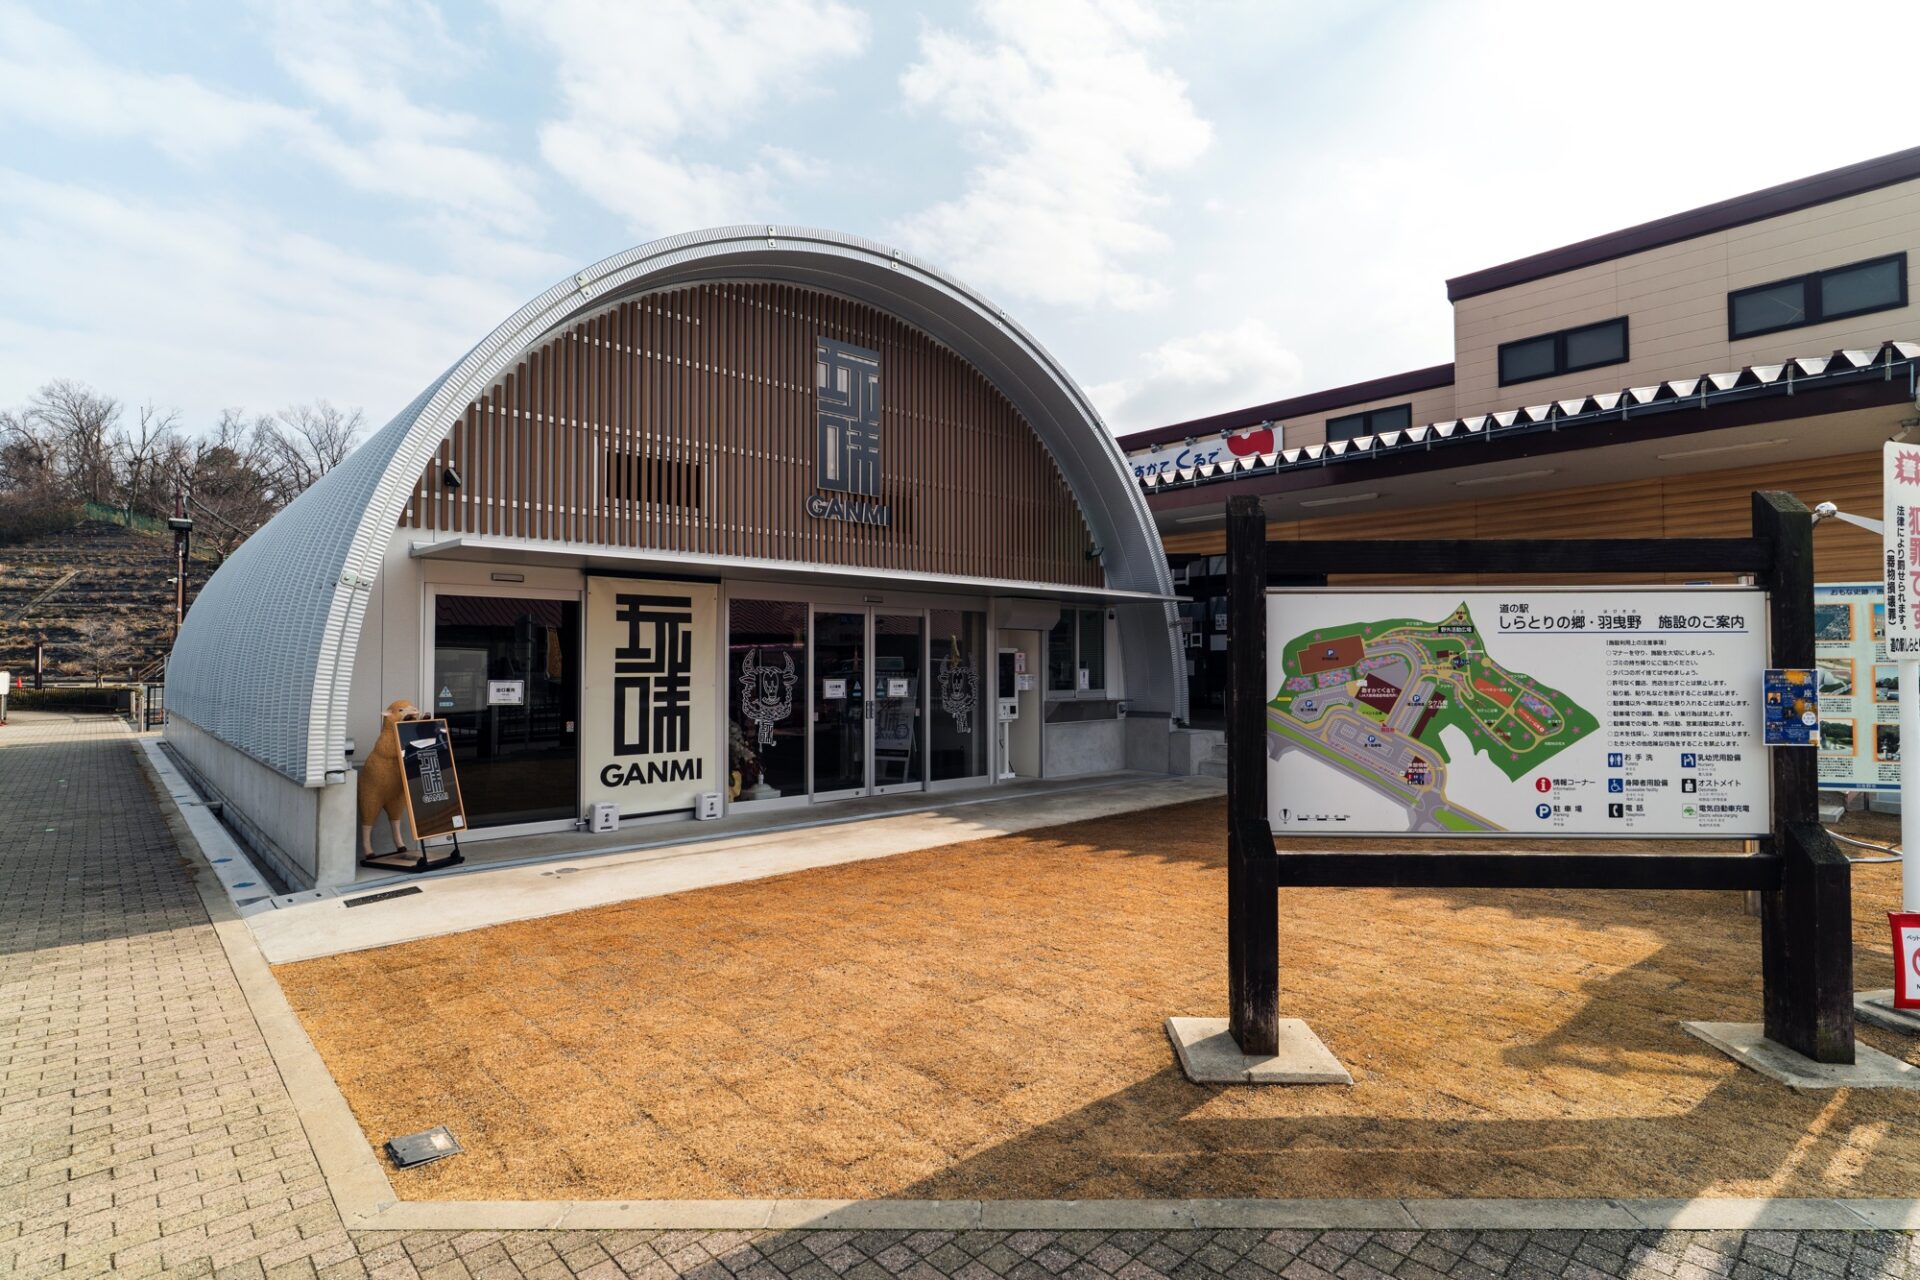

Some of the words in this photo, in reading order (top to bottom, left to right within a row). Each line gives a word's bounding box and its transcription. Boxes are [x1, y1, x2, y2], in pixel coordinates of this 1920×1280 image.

[1129, 447, 1222, 477] すかてくるで
[807, 495, 889, 527] GANMI
[1499, 603, 1529, 613] 道の駅
[1499, 615, 1642, 630] しらとりの郷・羽曳野
[1658, 614, 1745, 629] 施設のご案内
[1890, 638, 1920, 653] 道の駅しらと
[600, 758, 702, 788] GANMI
[1553, 778, 1596, 786] 情報コーナー
[1698, 779, 1742, 787] オストメイト
[1625, 804, 1643, 812] 電話
